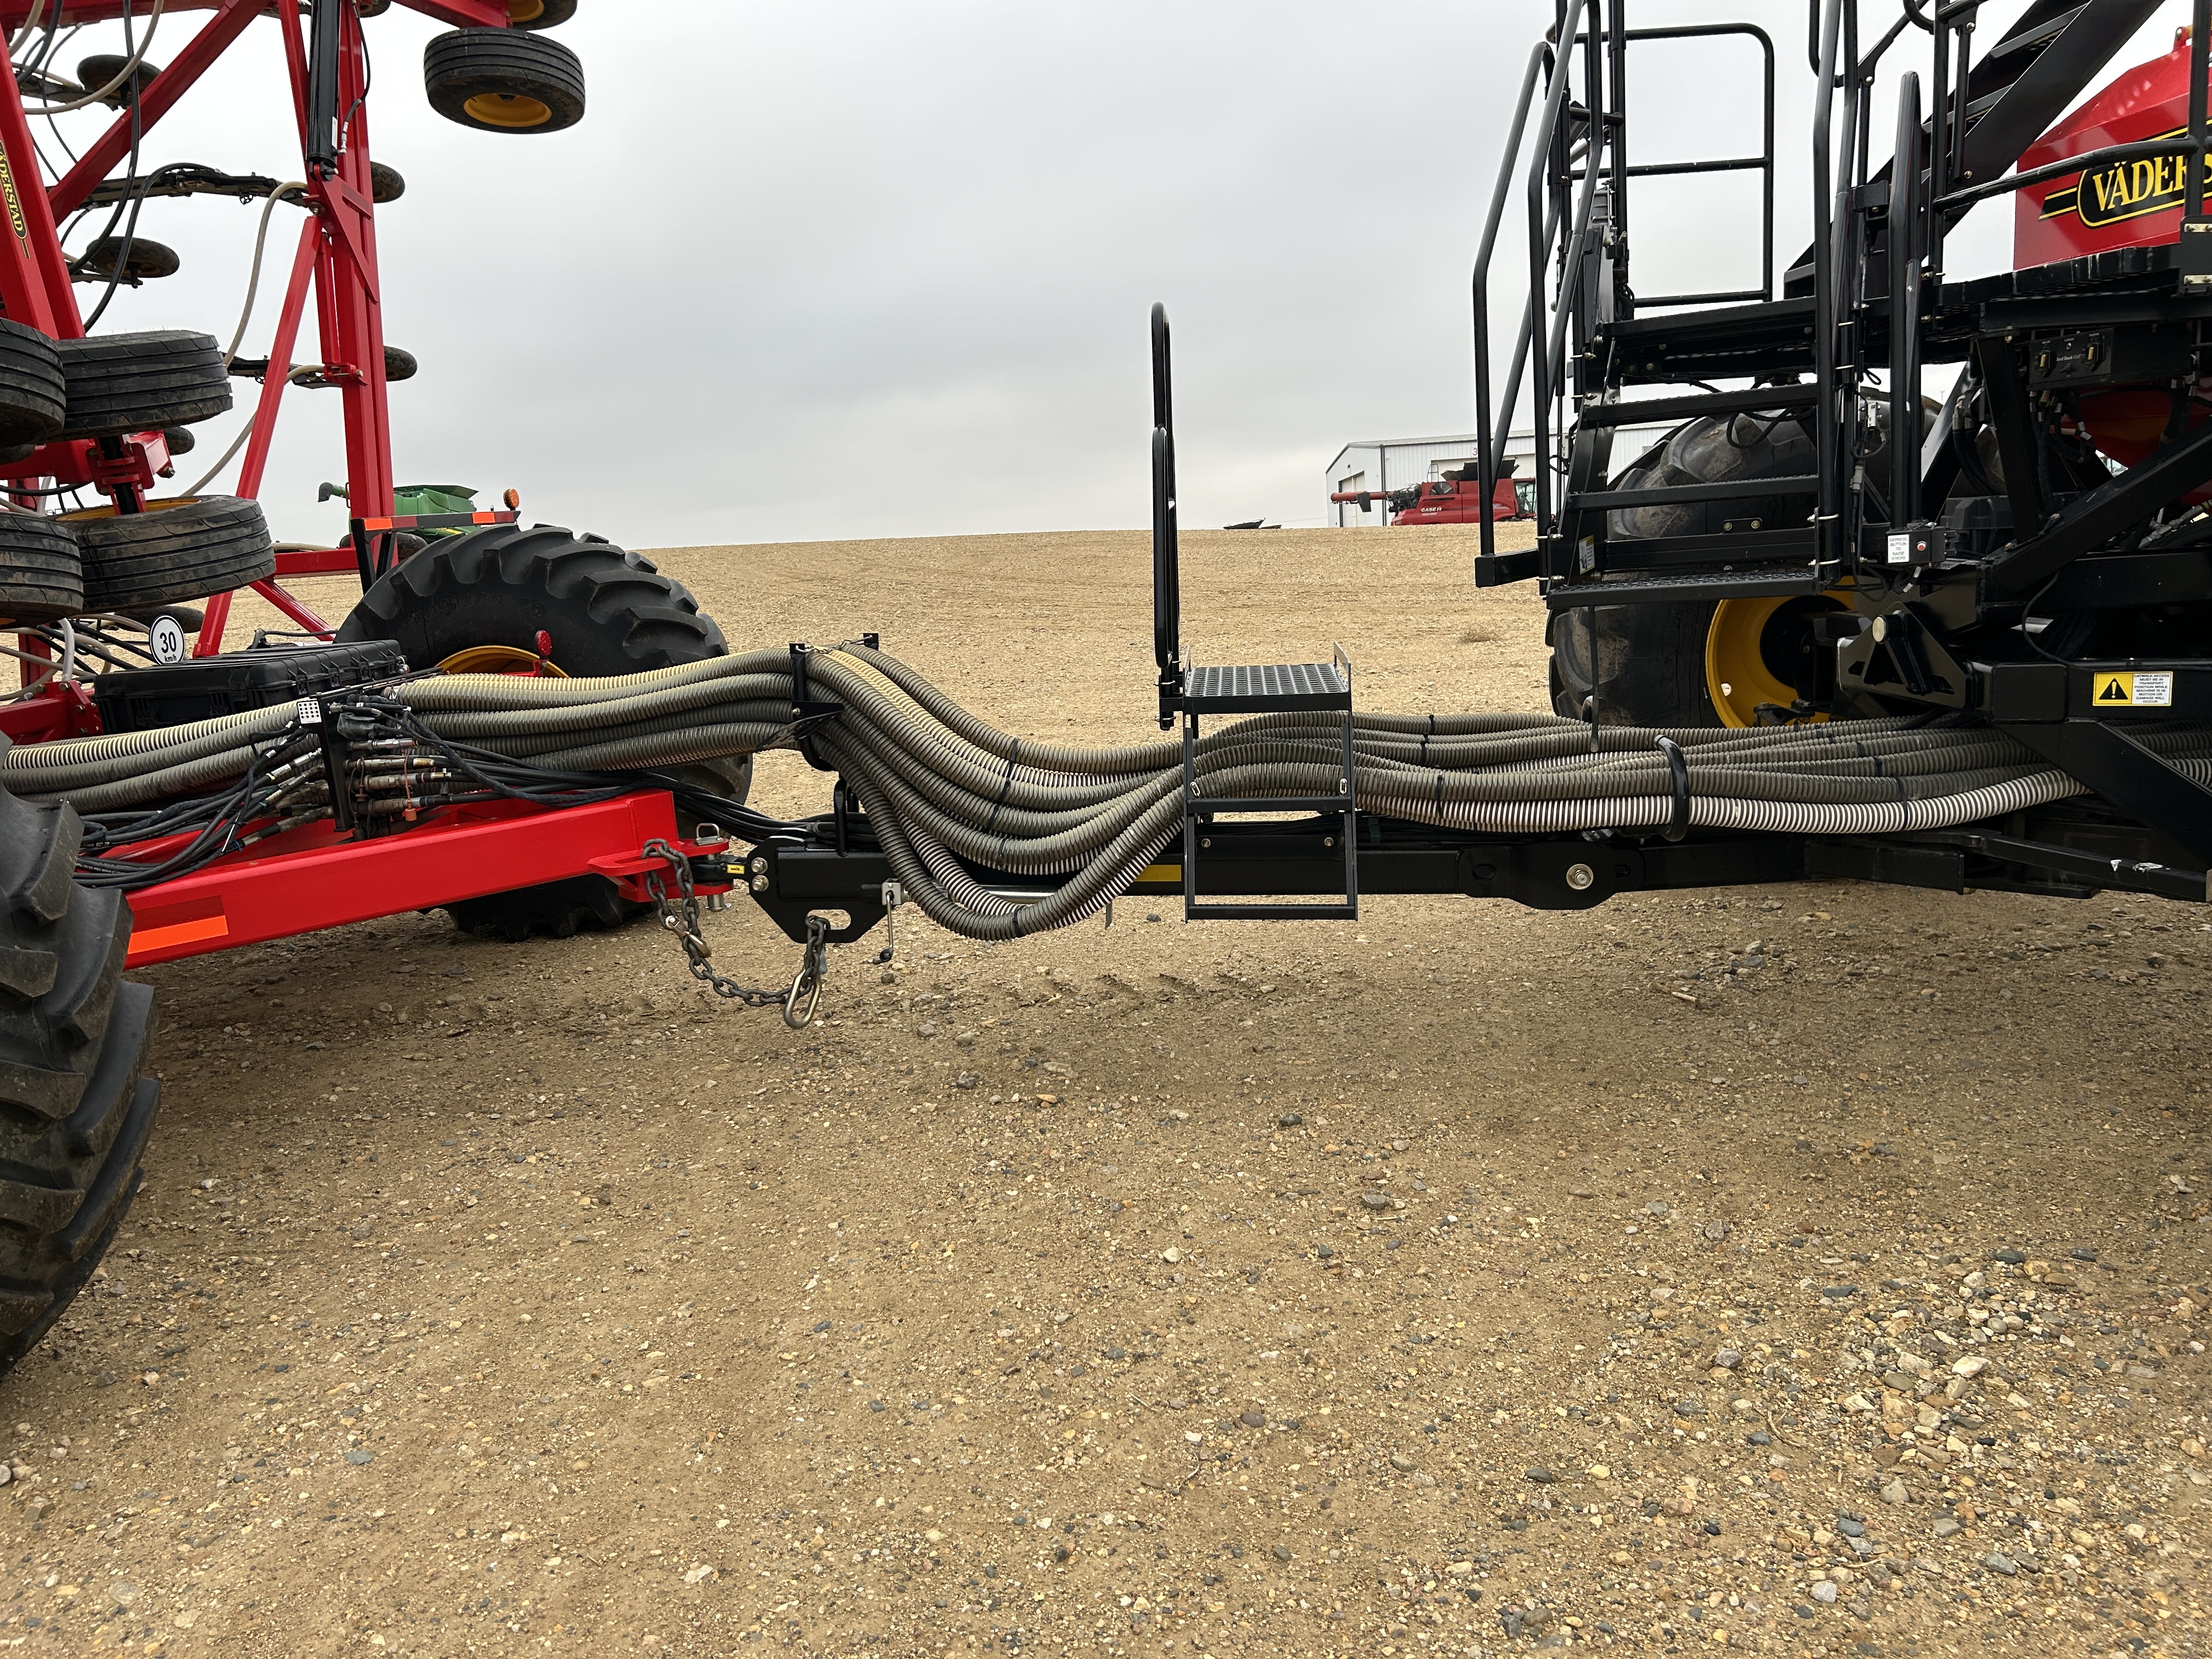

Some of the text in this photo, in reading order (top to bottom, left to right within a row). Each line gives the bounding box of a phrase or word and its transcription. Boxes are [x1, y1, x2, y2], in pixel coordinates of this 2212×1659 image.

[0, 145, 22, 231] ÄDERSTAD
[160, 631, 176, 653] 30
[165, 654, 177, 662] km/h
